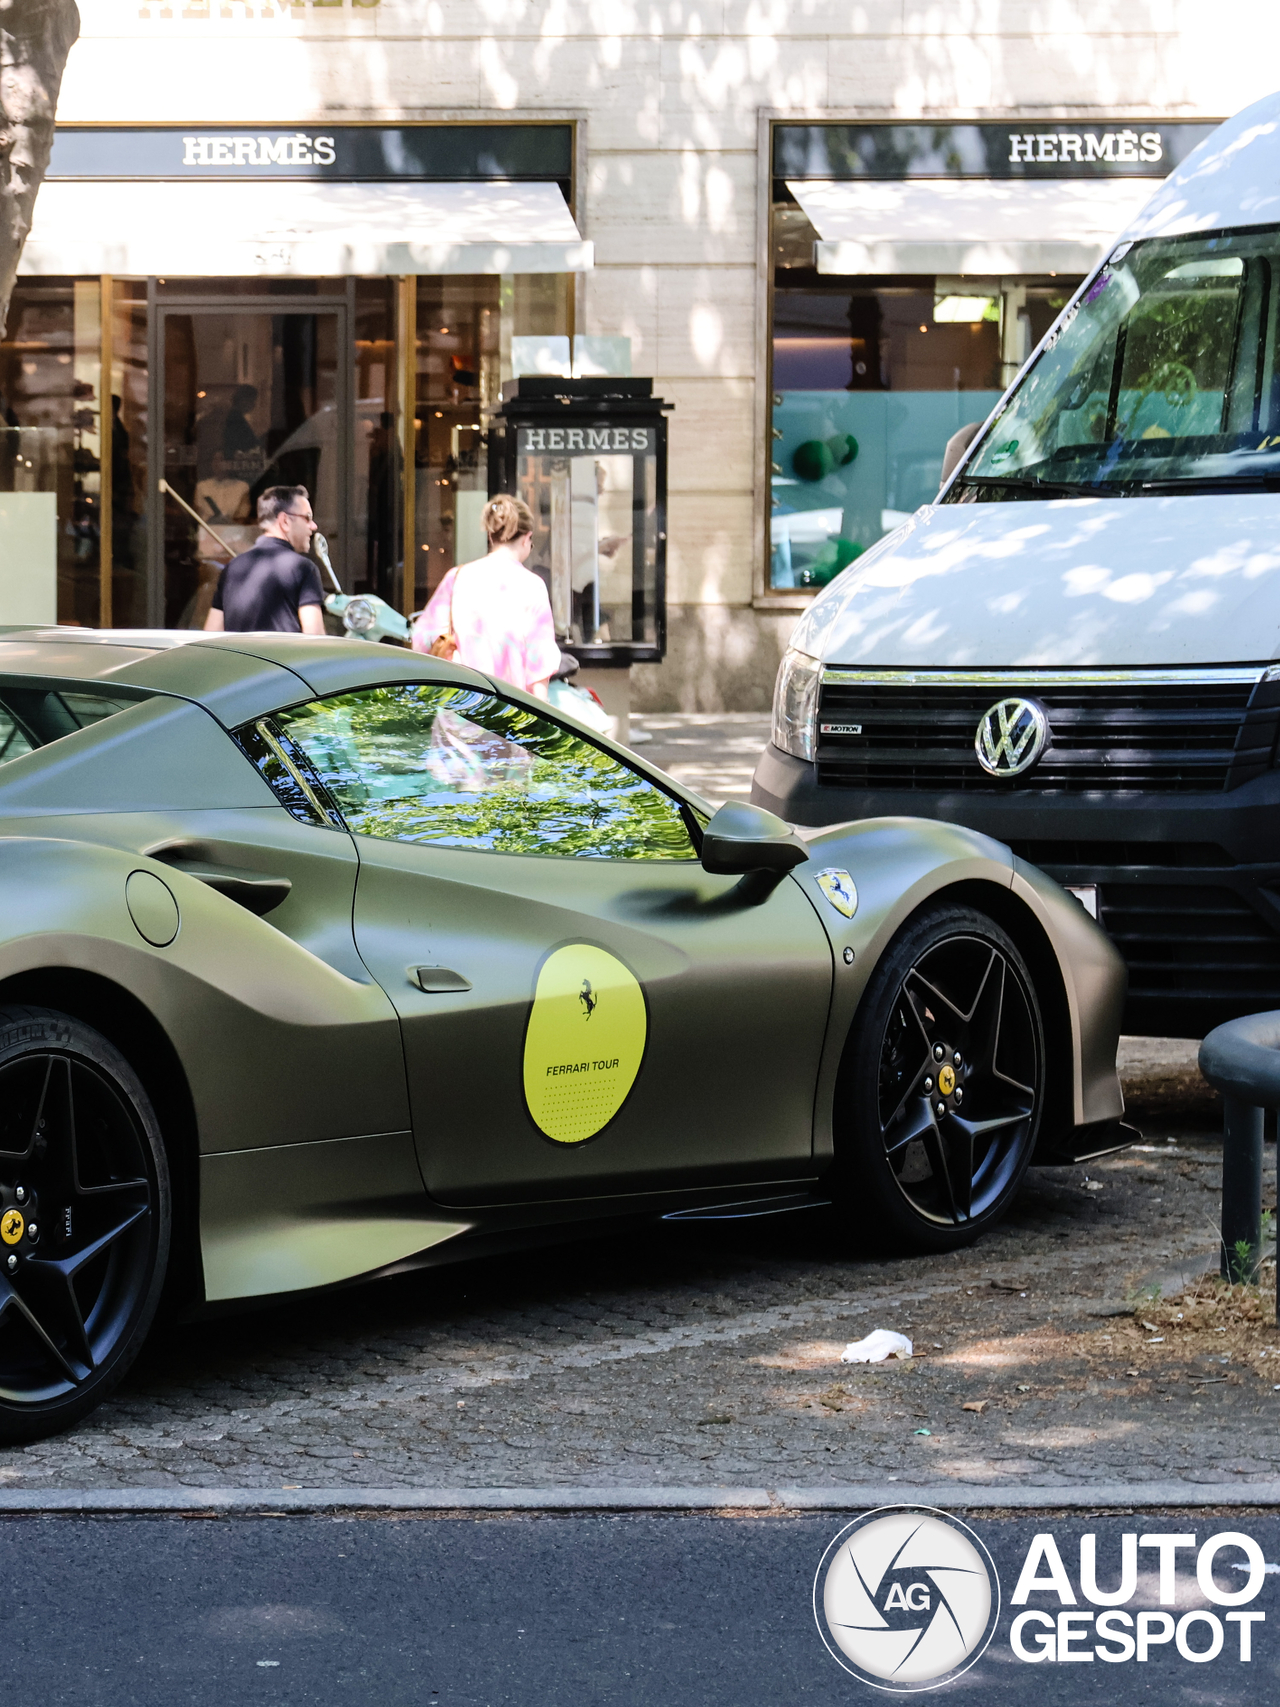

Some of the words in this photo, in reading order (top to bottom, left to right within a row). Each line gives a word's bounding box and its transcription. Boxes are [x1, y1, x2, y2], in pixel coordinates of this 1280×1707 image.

[182, 133, 337, 165] HERMÈS
[1008, 129, 1163, 162] HERMÈS
[546, 1062, 590, 1076] FERRARI
[592, 1058, 620, 1070] TOUR
